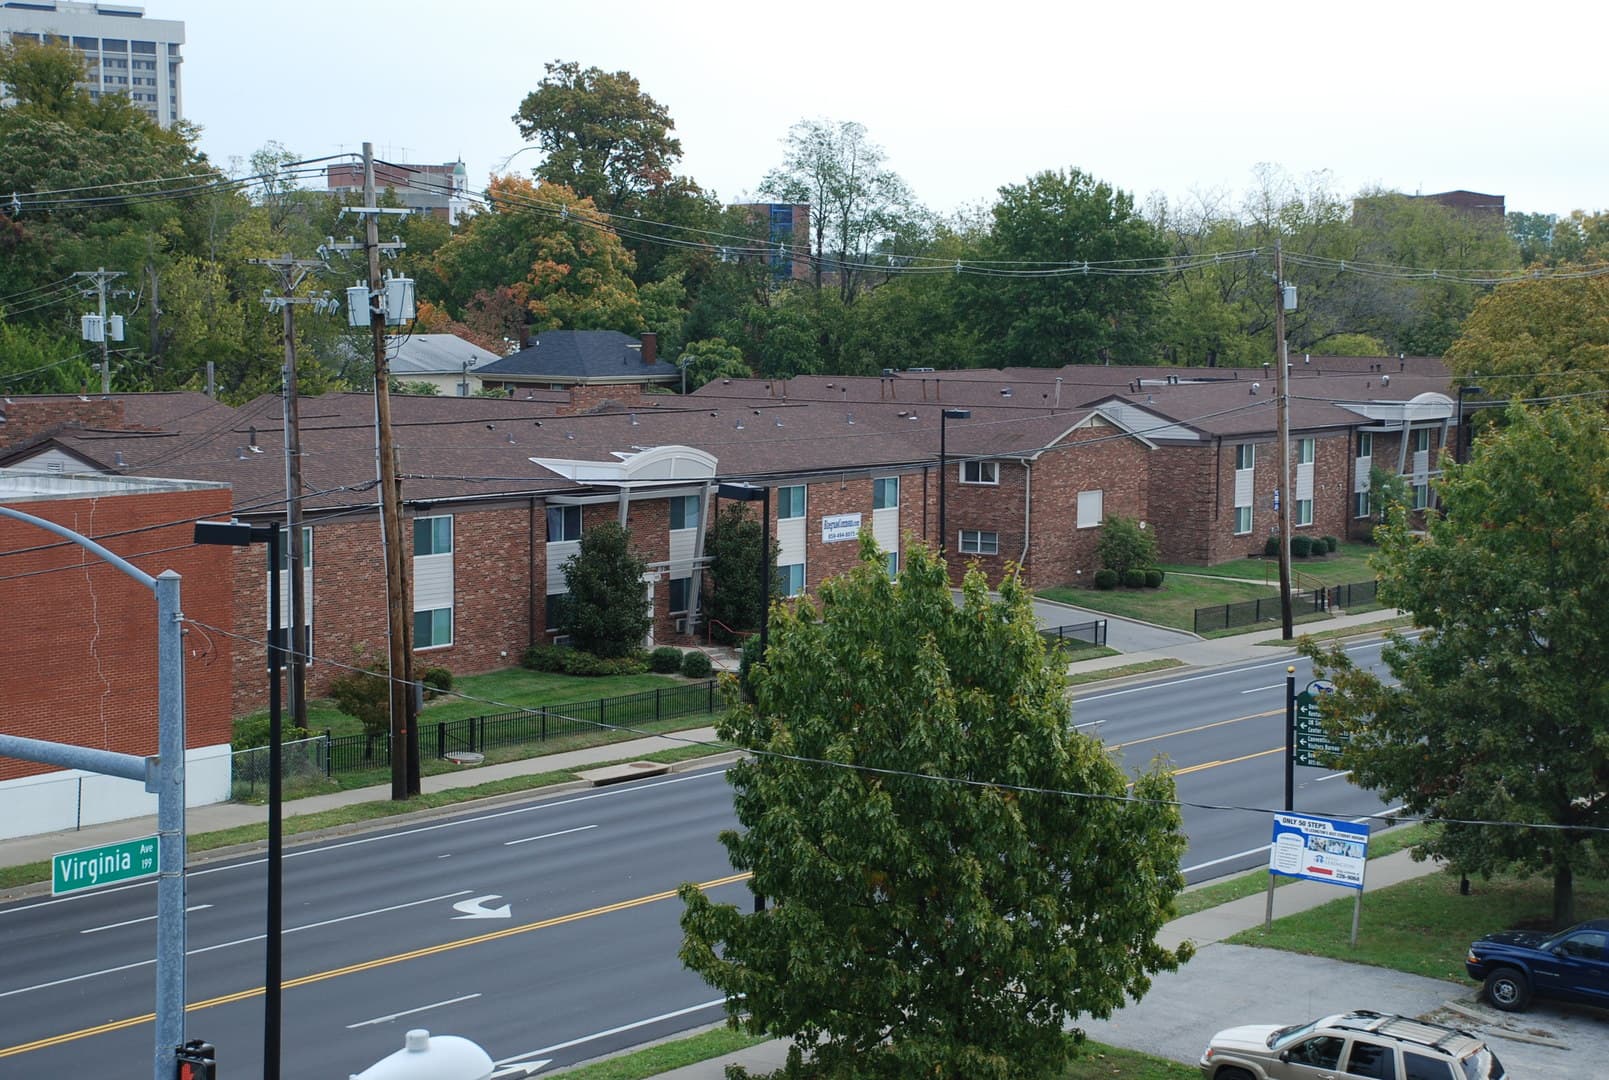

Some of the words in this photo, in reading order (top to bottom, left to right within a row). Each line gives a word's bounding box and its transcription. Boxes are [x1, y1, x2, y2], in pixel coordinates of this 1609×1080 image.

[1282, 817, 1297, 825] ONLY
[1298, 819, 1306, 827] 50
[1307, 821, 1327, 830] STEPS
[139, 844, 154, 854] Ave
[60, 848, 131, 884] Virginia
[141, 858, 152, 869] 199
